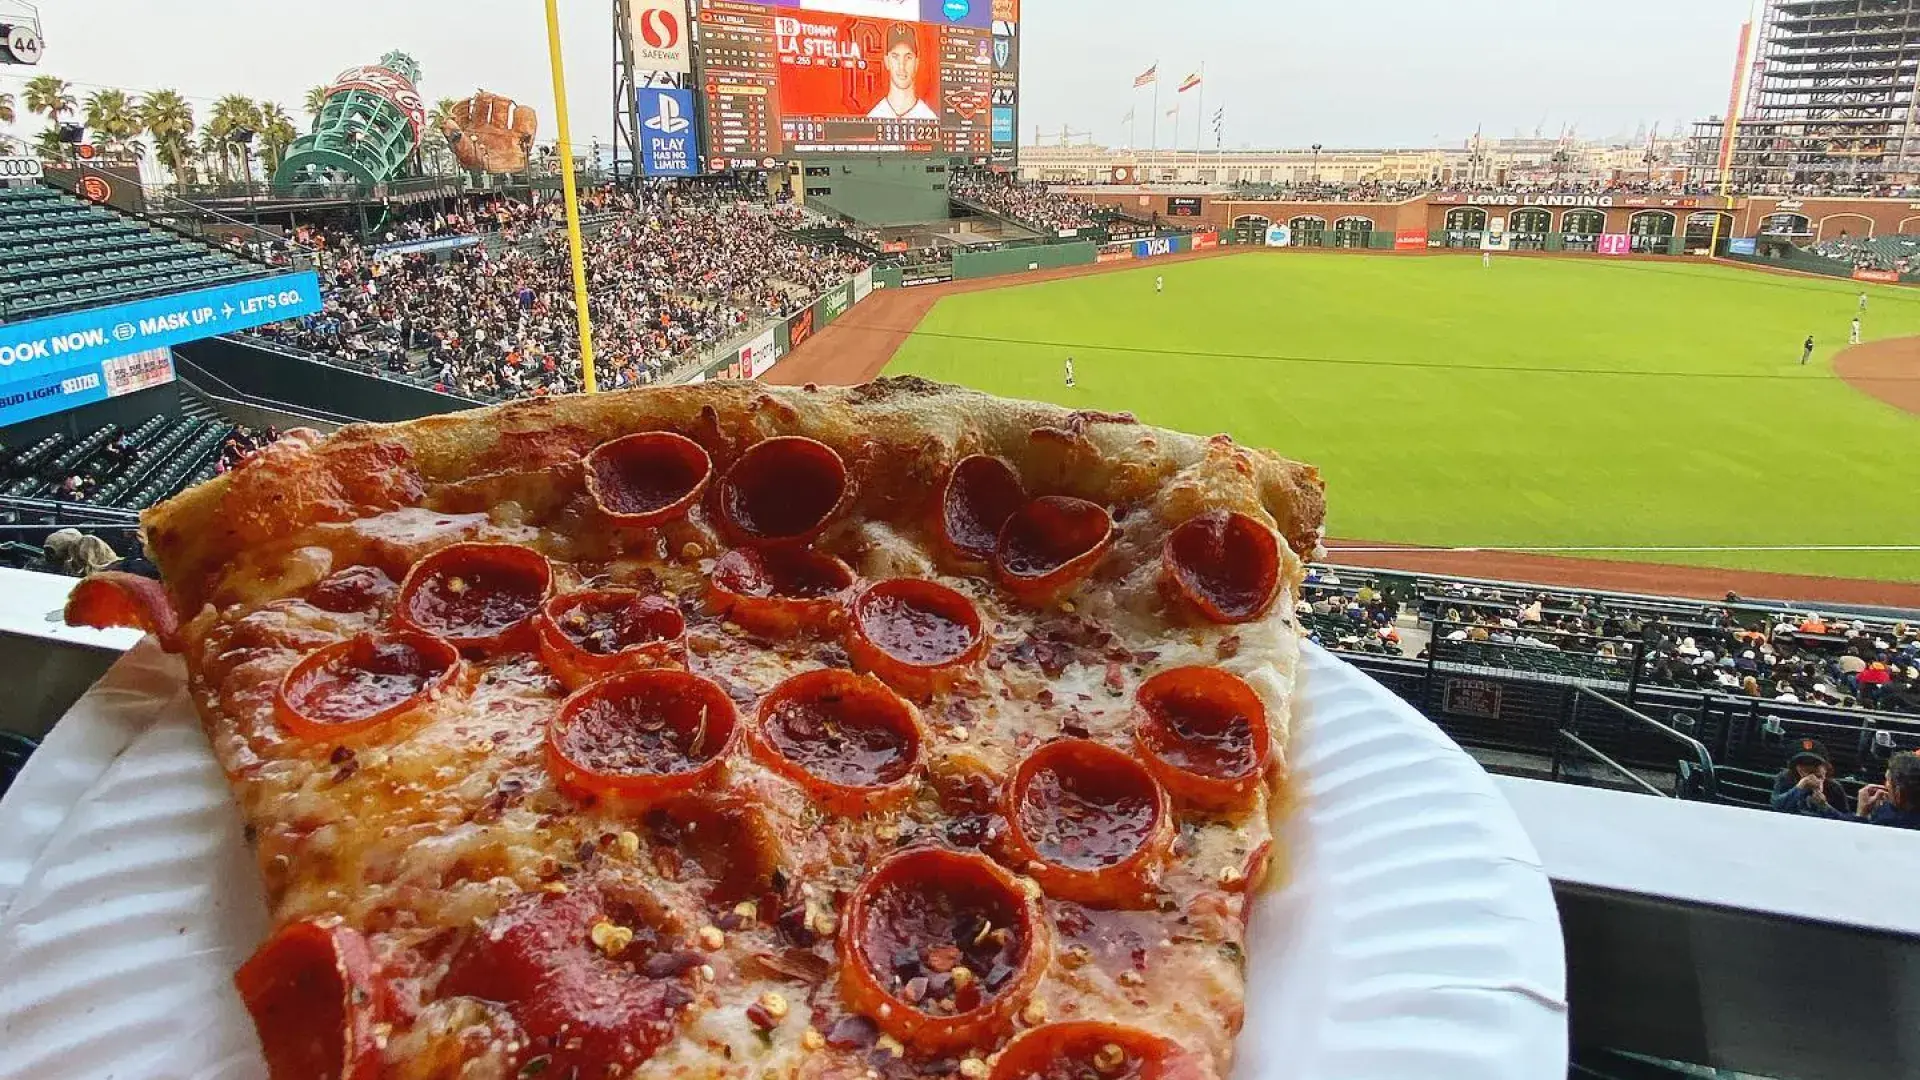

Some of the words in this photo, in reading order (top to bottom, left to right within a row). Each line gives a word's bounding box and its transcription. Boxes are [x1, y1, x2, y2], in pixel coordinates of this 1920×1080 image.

[779, 19, 794, 34] 18
[802, 24, 837, 37] TOMMY
[15, 37, 36, 53] 44
[777, 35, 800, 54] LA
[803, 38, 861, 59] STELLA
[642, 50, 680, 60] SAFEWAY
[652, 138, 685, 151] PLAY
[653, 152, 670, 160] HAS
[671, 152, 686, 160] NO
[654, 160, 689, 170] LIMITS.
[1523, 195, 1613, 207] LANDING
[1146, 239, 1170, 255] VISA
[240, 294, 277, 315] LET'S
[279, 290, 303, 307] GO.
[139, 312, 190, 337] MASK
[192, 308, 217, 324] UP.
[52, 329, 110, 355] NOW.
[26, 384, 62, 402] LIGHT
